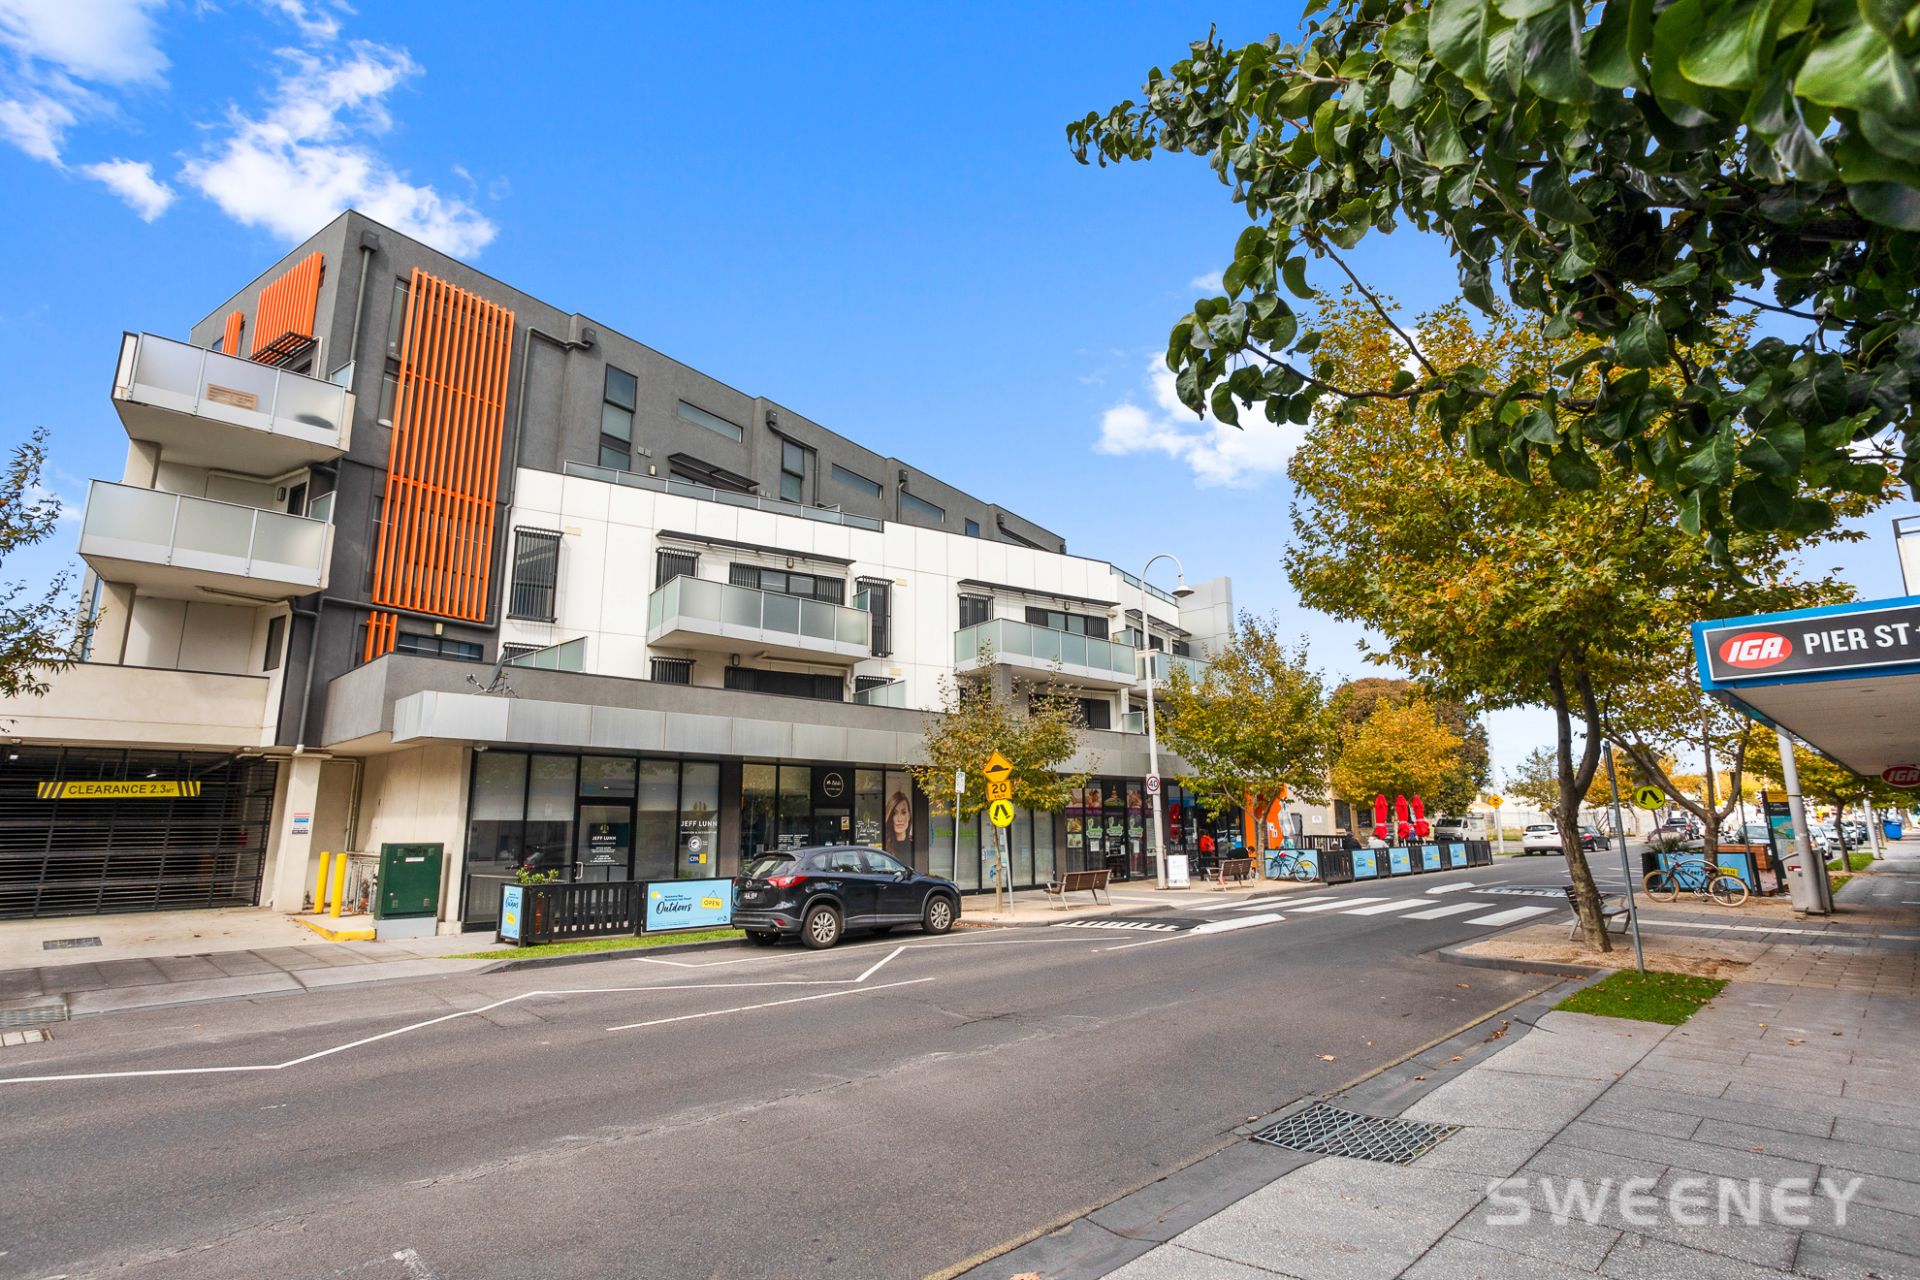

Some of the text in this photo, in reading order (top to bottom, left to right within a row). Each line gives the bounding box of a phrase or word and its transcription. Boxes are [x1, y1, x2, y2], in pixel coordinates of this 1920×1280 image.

[1728, 622, 1909, 662] IGA PIER ST
[1887, 770, 1920, 782] IGA
[68, 785, 146, 794] CLEARANCE
[992, 783, 1007, 793] 20
[1149, 780, 1158, 788] 40
[656, 901, 692, 915] Outdoors
